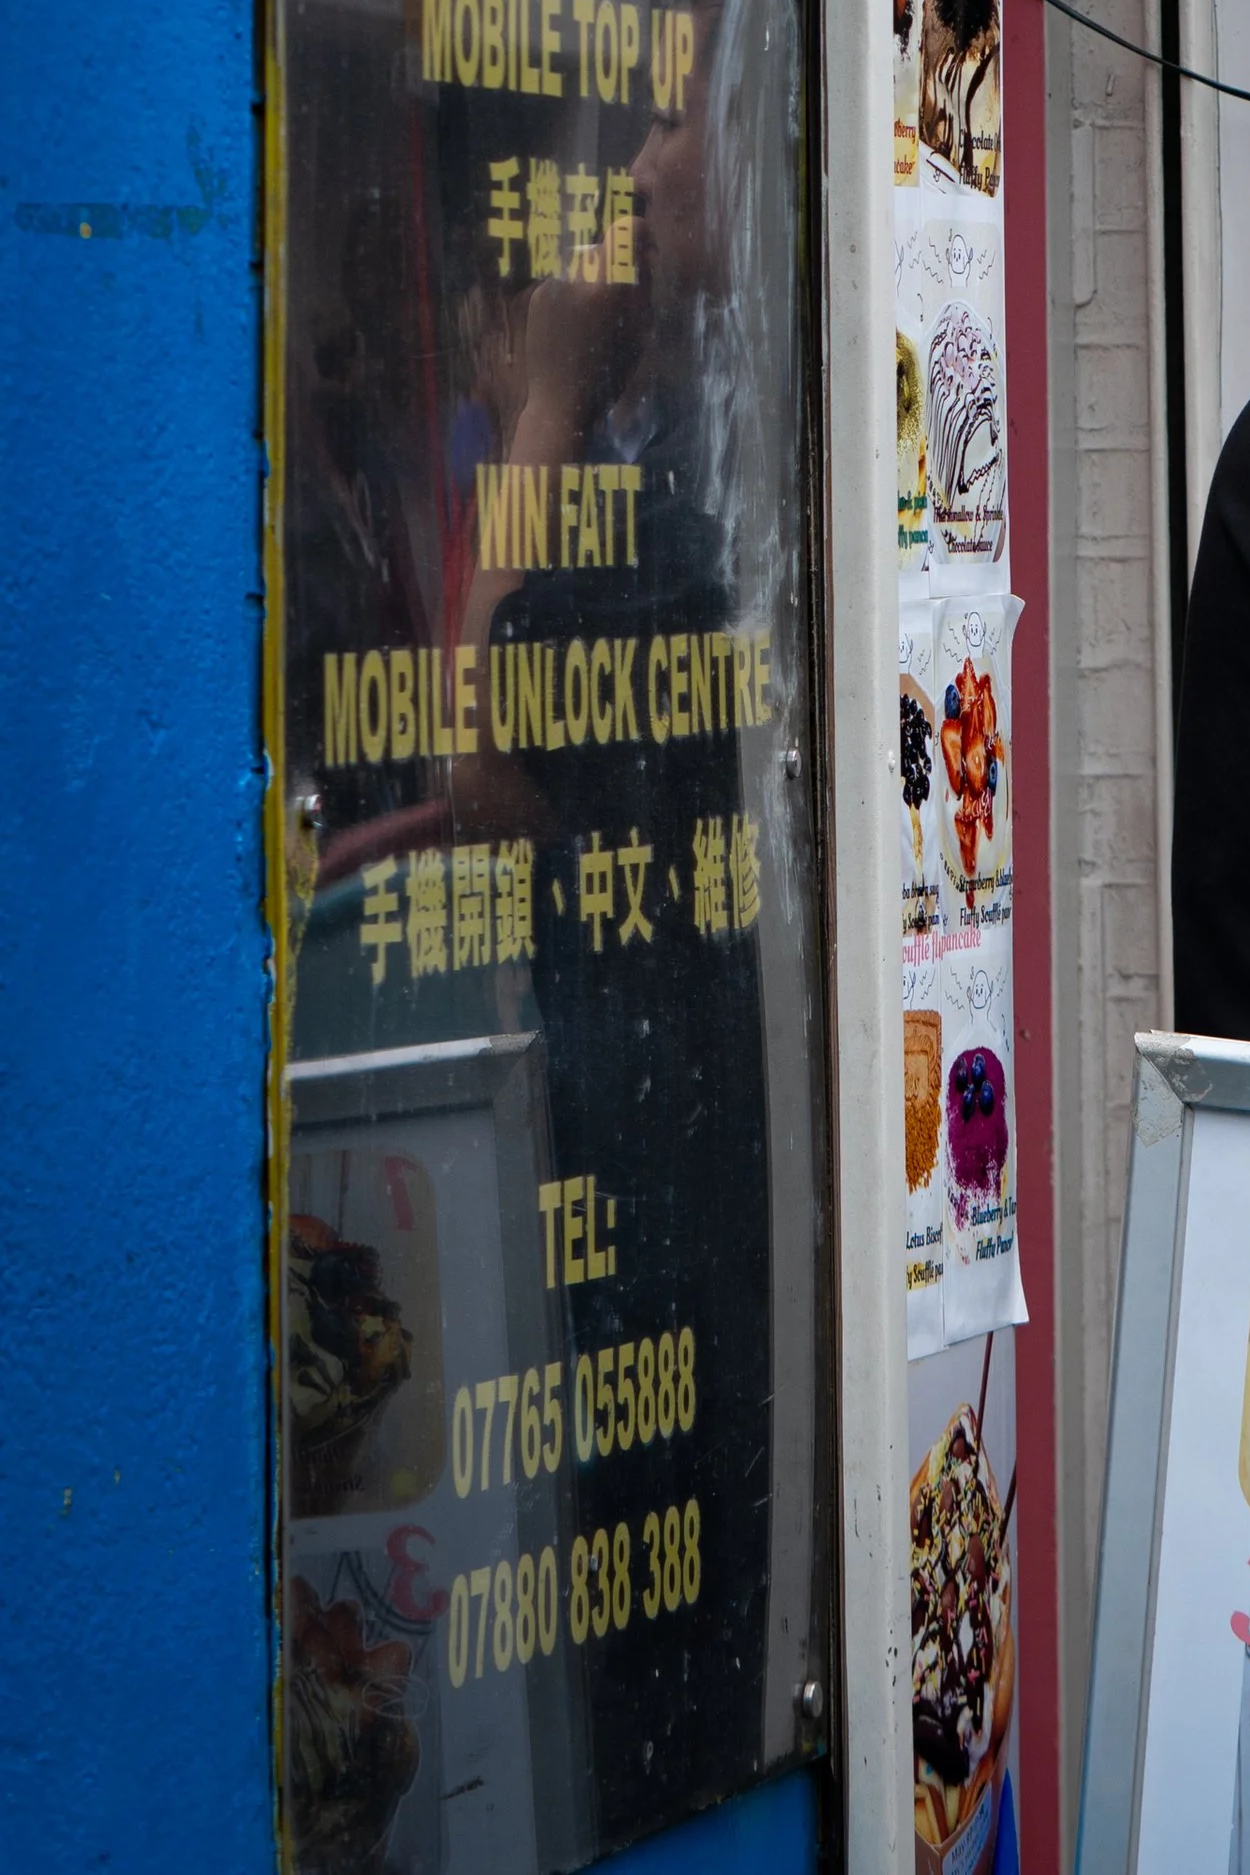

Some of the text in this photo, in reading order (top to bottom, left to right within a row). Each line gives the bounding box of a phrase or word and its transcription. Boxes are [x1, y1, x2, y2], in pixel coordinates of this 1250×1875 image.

[651, 8, 695, 111] UP
[487, 155, 639, 285] 手機充值
[476, 463, 644, 570] WIN FATT
[323, 628, 772, 769] MOBILE UNLOCK CENTRE
[941, 922, 981, 961] pancake
[539, 1176, 617, 1289] TEL:
[906, 1231, 925, 1249] Lotus
[452, 1361, 563, 1499] 07765
[575, 1326, 696, 1464] 055888
[449, 1498, 701, 1689] 07880 838 388
